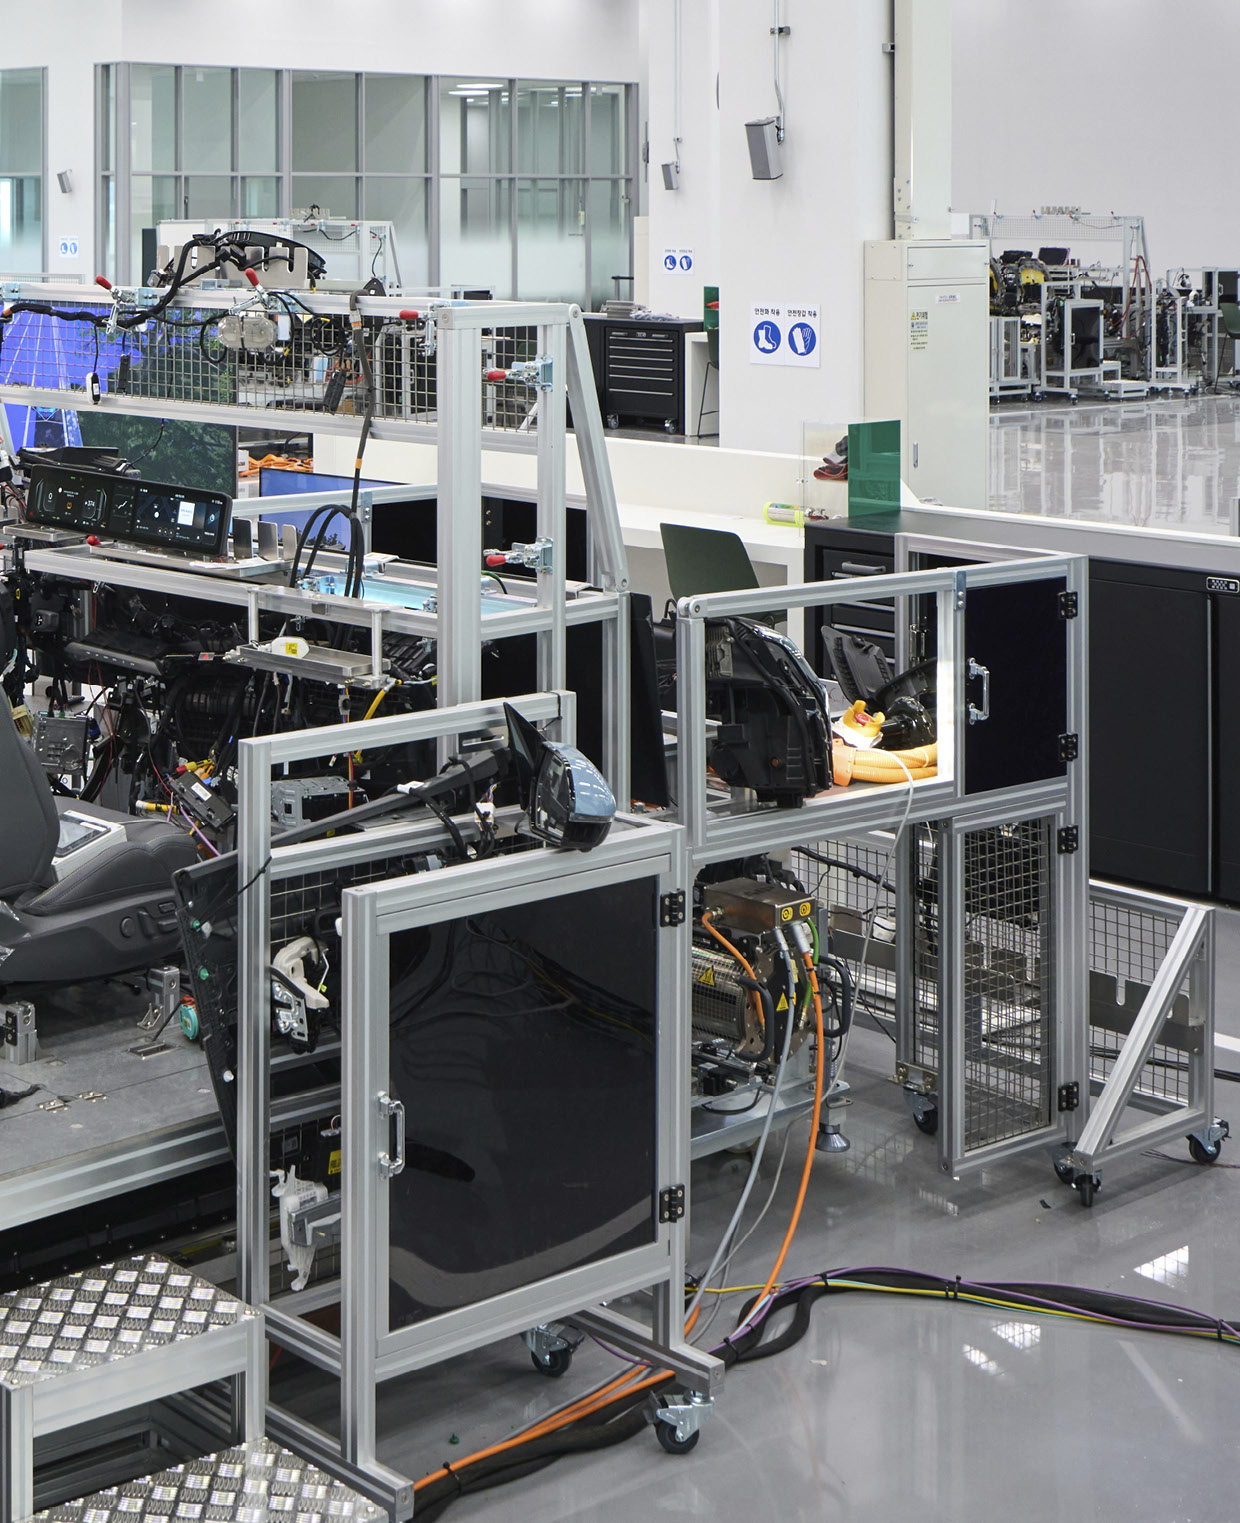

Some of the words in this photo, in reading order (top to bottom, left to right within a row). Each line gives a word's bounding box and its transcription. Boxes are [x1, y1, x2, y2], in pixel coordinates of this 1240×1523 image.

[754, 307, 769, 315] 안전화
[771, 308, 780, 316] 착용
[787, 309, 806, 317] 안전장갑
[808, 310, 817, 318] 착용
